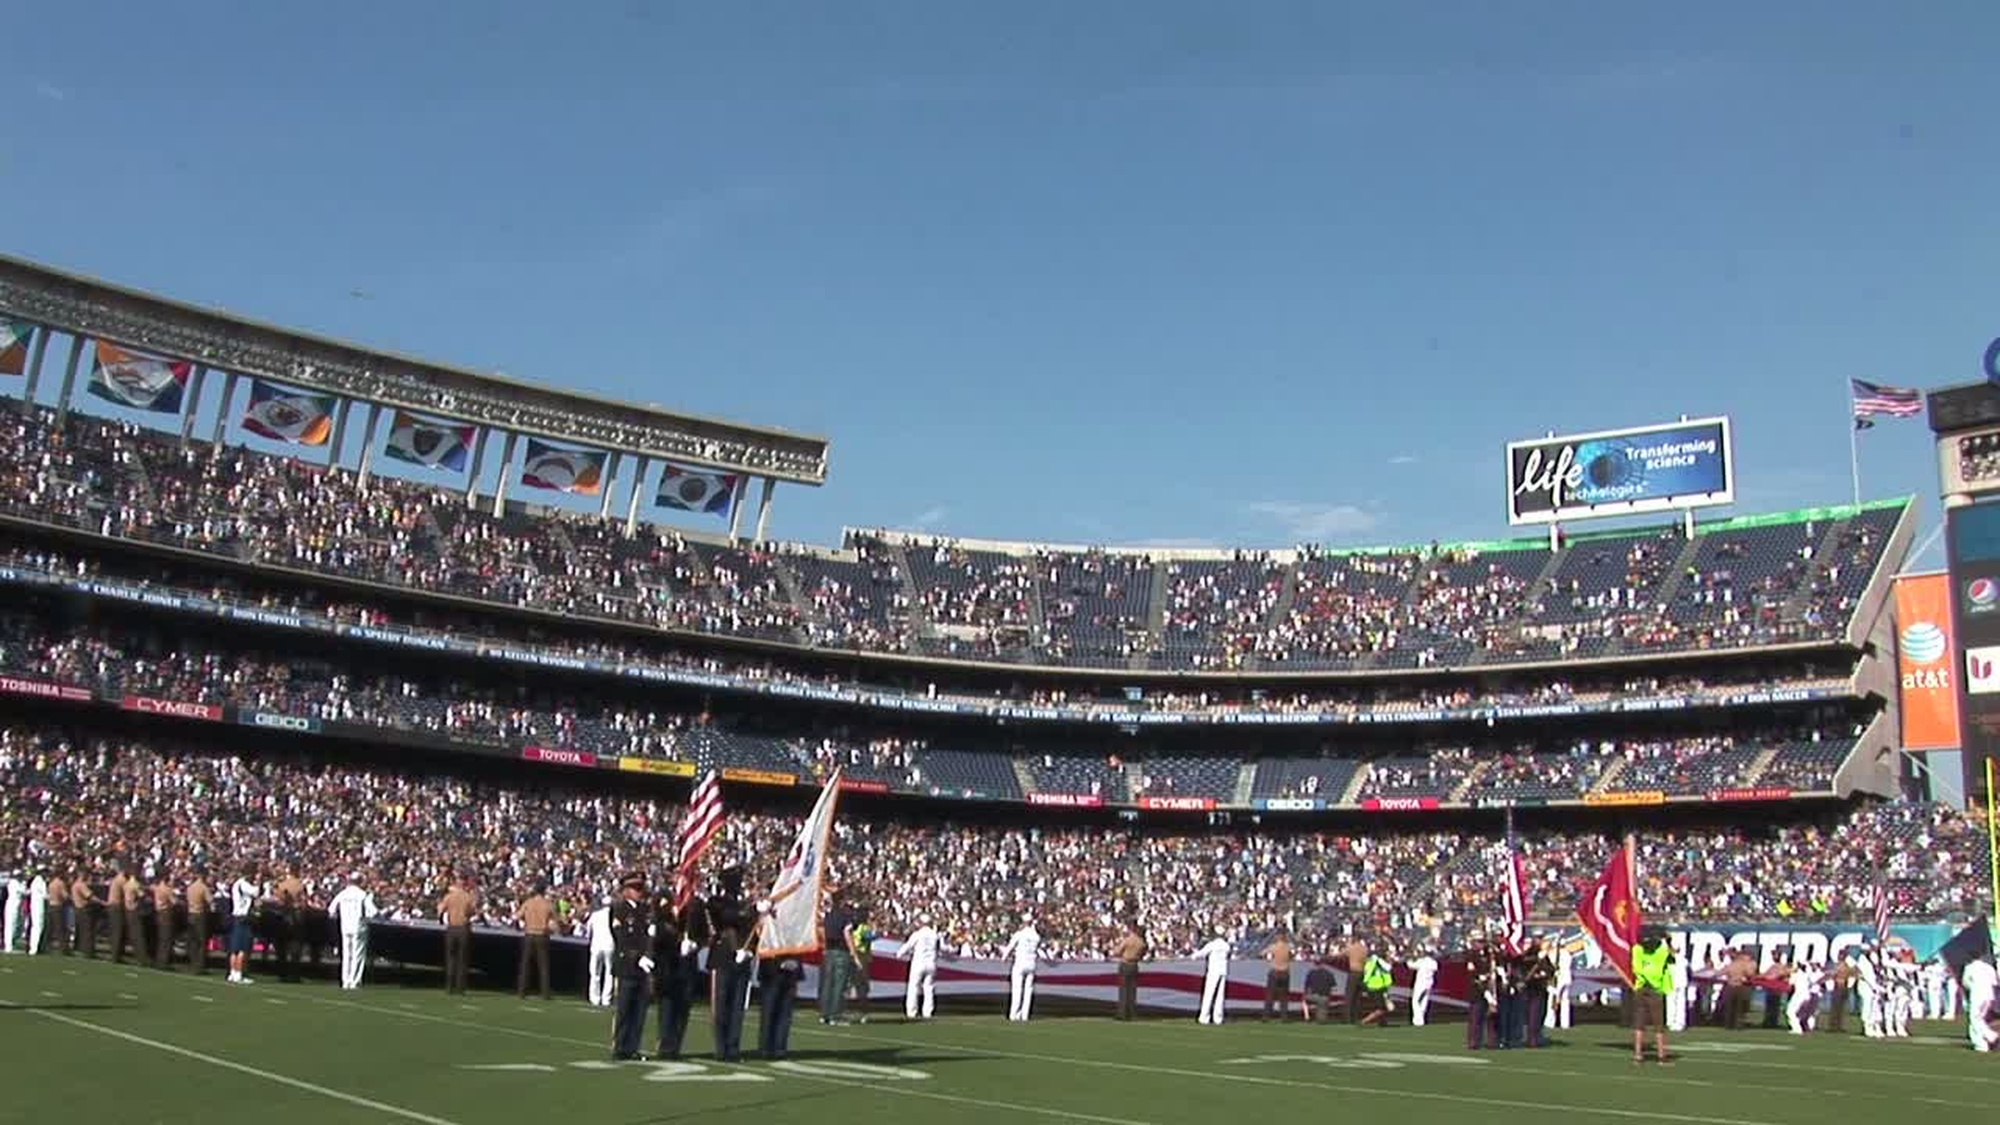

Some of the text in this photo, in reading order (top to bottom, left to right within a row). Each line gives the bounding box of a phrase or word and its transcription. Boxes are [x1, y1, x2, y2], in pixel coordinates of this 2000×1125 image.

[1625, 439, 1717, 461] Transforming
[1646, 454, 1696, 470] science
[1515, 445, 1583, 507] life
[403, 635, 447, 650] DUNCAN
[1902, 668, 1950, 689] at&t
[0, 678, 60, 697] TOSHIBA
[137, 698, 210, 718] CYMER
[255, 713, 309, 730] GEICO
[538, 748, 581, 764] TOYOTA
[1029, 794, 1076, 805] TOSHIBA
[1148, 798, 1204, 810] CYMER
[1266, 799, 1315, 810] GEICO
[1379, 799, 1421, 810] TOYOTA
